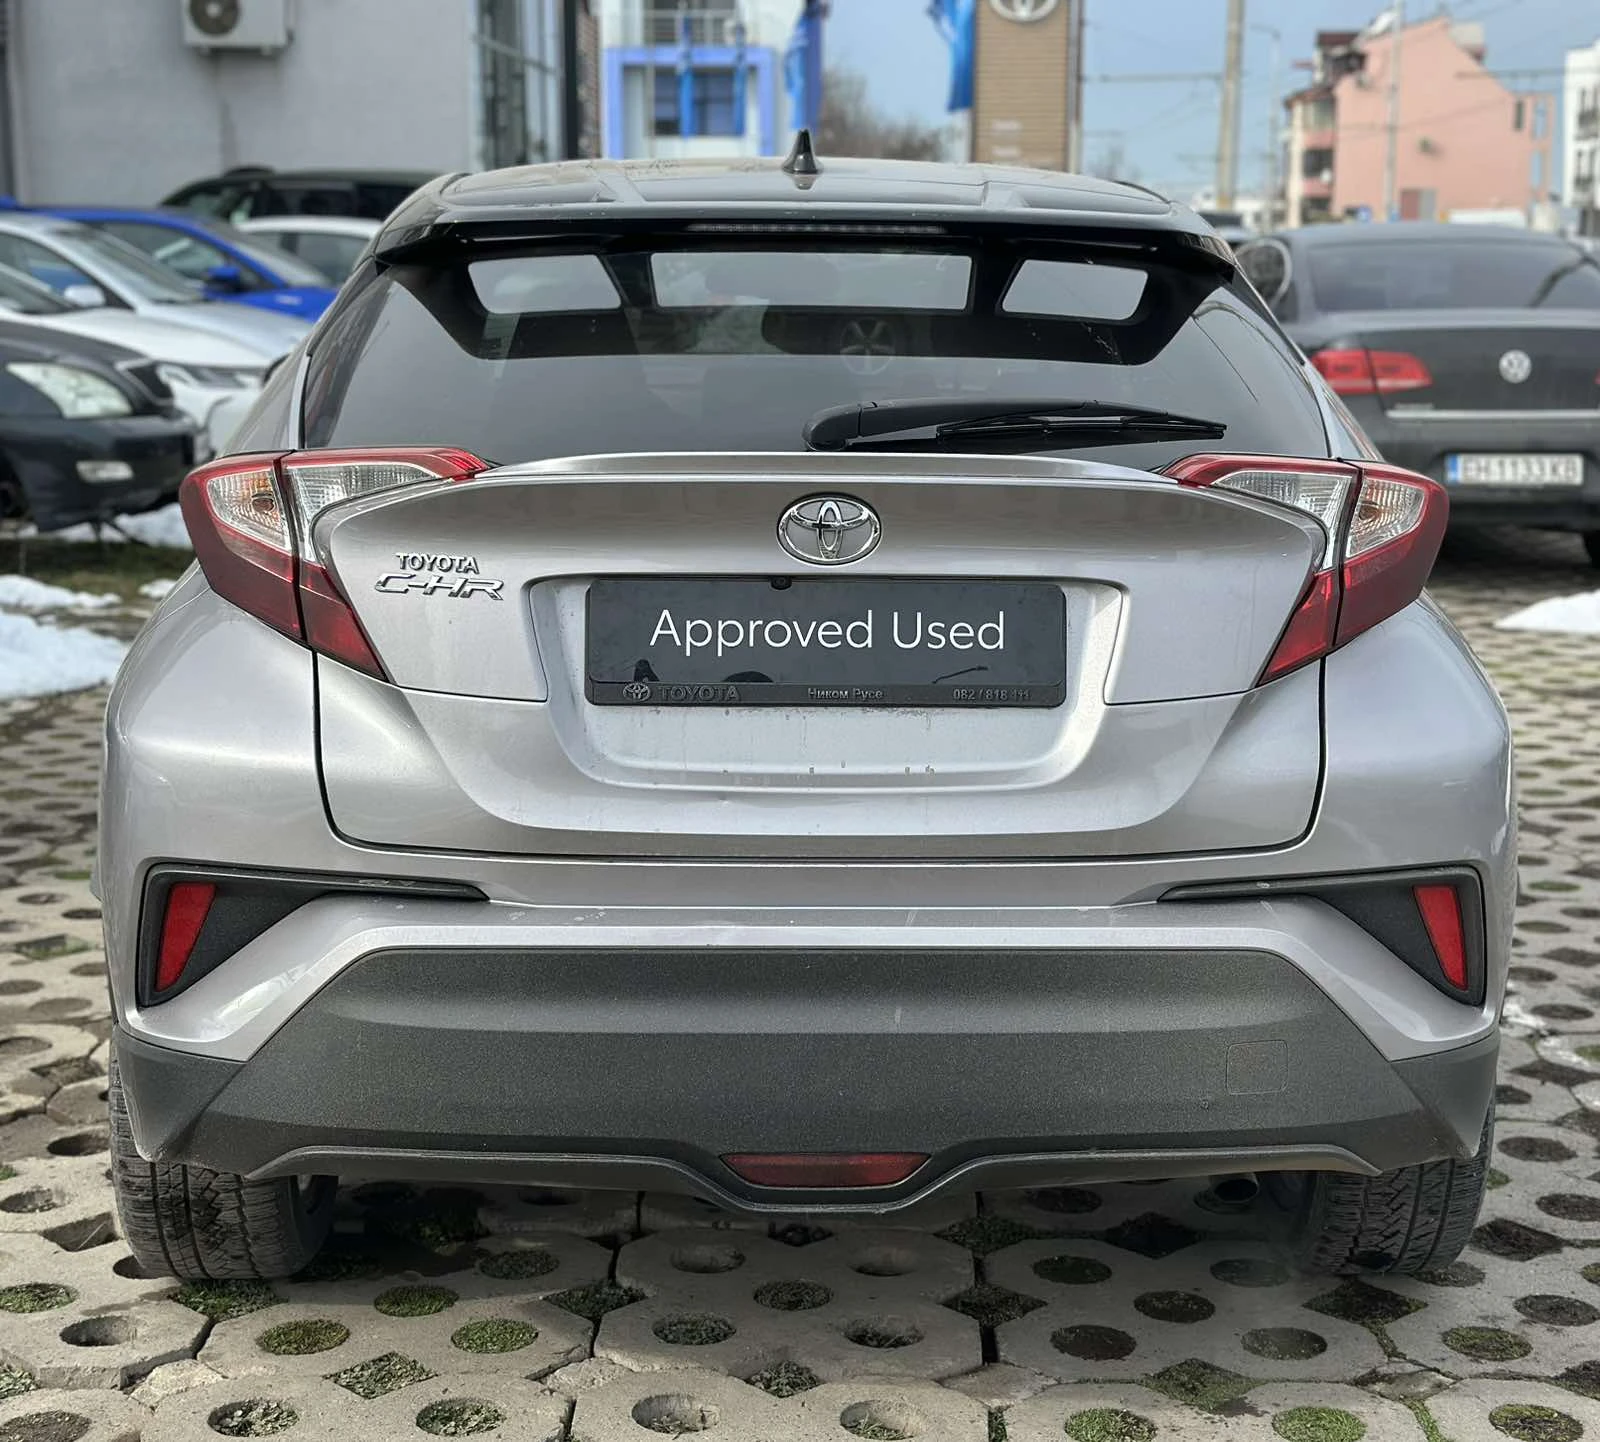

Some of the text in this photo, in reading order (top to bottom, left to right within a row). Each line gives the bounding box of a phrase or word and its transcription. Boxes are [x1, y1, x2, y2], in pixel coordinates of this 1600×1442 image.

[395, 552, 480, 575] TOYOTA
[375, 572, 504, 601] C-HR
[649, 608, 1005, 656] Approved Used
[658, 685, 741, 701] TOYOTA
[807, 687, 883, 700] Ником Русе
